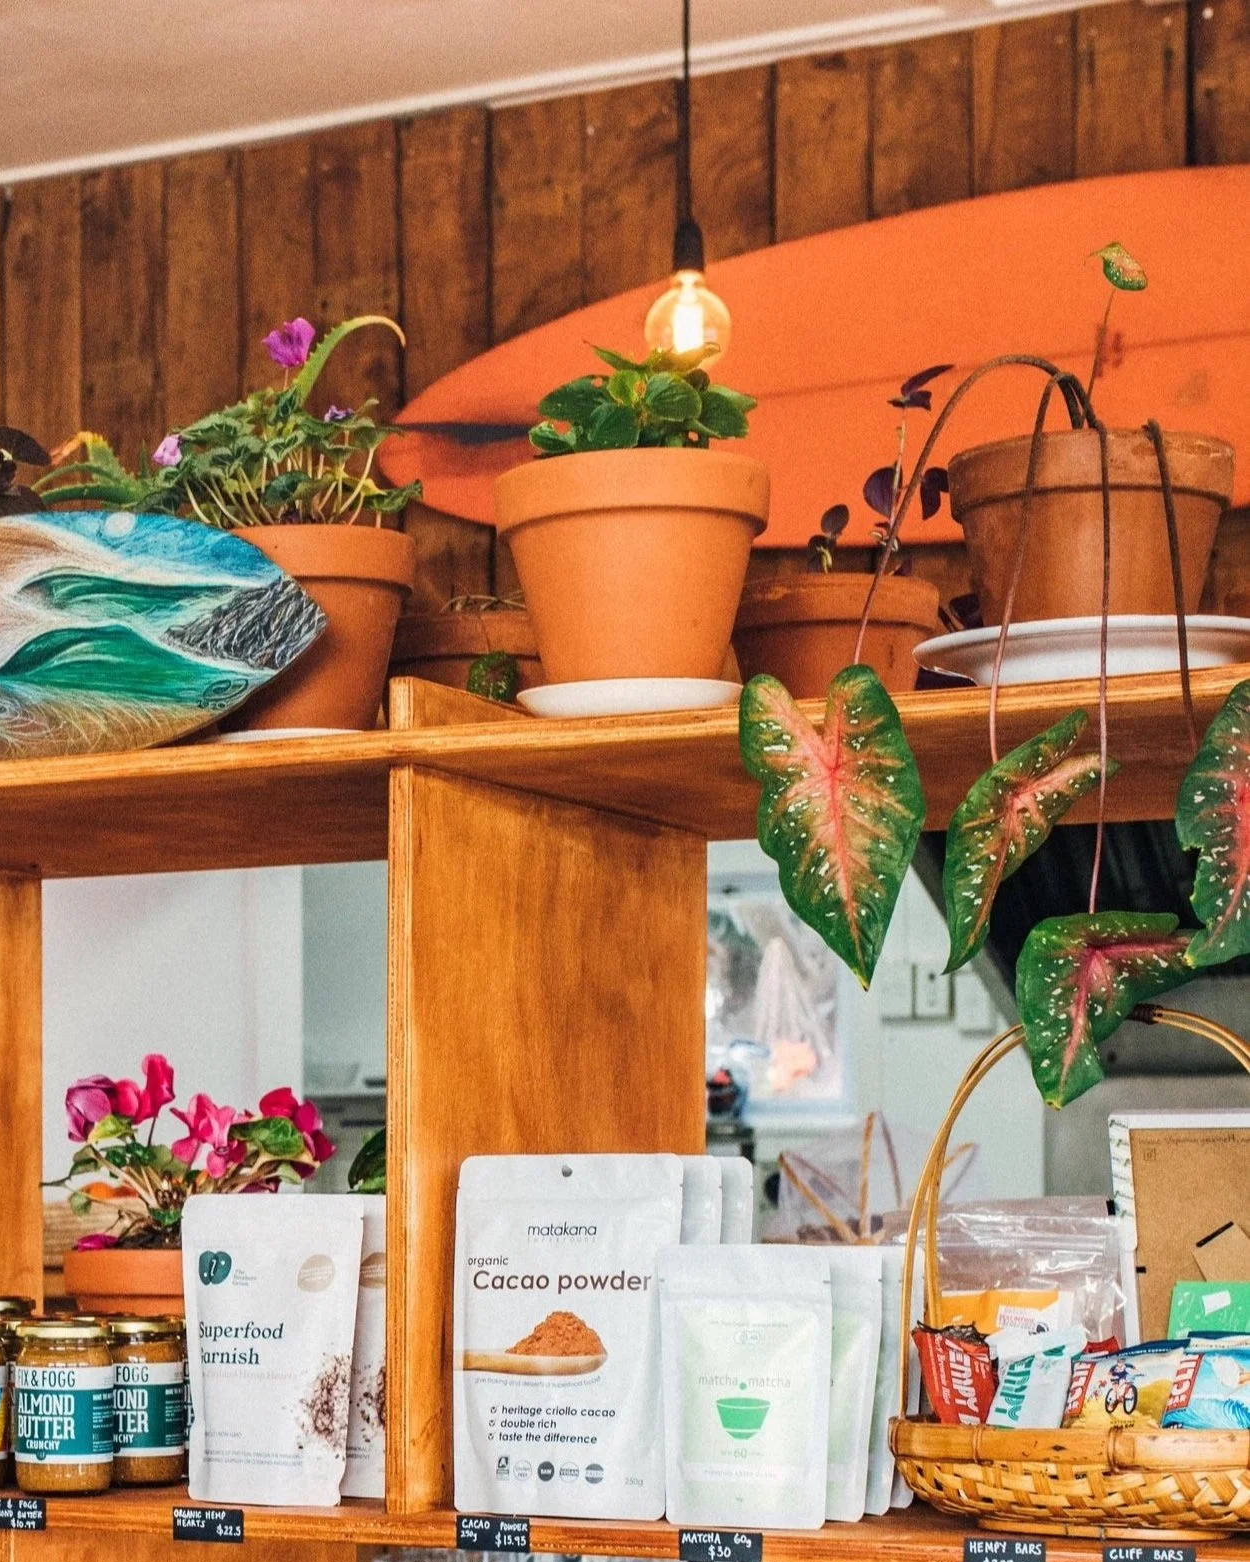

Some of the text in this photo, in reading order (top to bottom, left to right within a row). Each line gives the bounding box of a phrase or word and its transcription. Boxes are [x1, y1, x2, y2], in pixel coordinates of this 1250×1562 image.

[527, 1223, 597, 1236] matakana
[468, 1256, 509, 1267] organic
[473, 1270, 651, 1294] Cacao powder
[199, 1320, 284, 1343] Superfood
[18, 1370, 75, 1387] FIX & FOGG
[699, 1374, 790, 1388] matcha matcha
[18, 1394, 75, 1415] ALMOND
[502, 1405, 616, 1417] heritage criollo cacao
[18, 1417, 75, 1440] BUTTER
[500, 1419, 556, 1428] double rich
[26, 1439, 60, 1451] CRUNCHY
[499, 1433, 597, 1444] taste the difference
[173, 1509, 226, 1521] ORGANIC HEMP
[10, 1518, 36, 1529] $10.99
[177, 1518, 241, 1536] HEARTS $22.5
[461, 1519, 528, 1532] CACAO POWDER
[460, 1530, 527, 1548] 250g $15.95
[681, 1532, 752, 1547] MATCHA 60g
[708, 1545, 732, 1559] $30
[969, 1540, 1042, 1556] HEMPY BARS
[1109, 1548, 1183, 1562] CLIFF BARS
